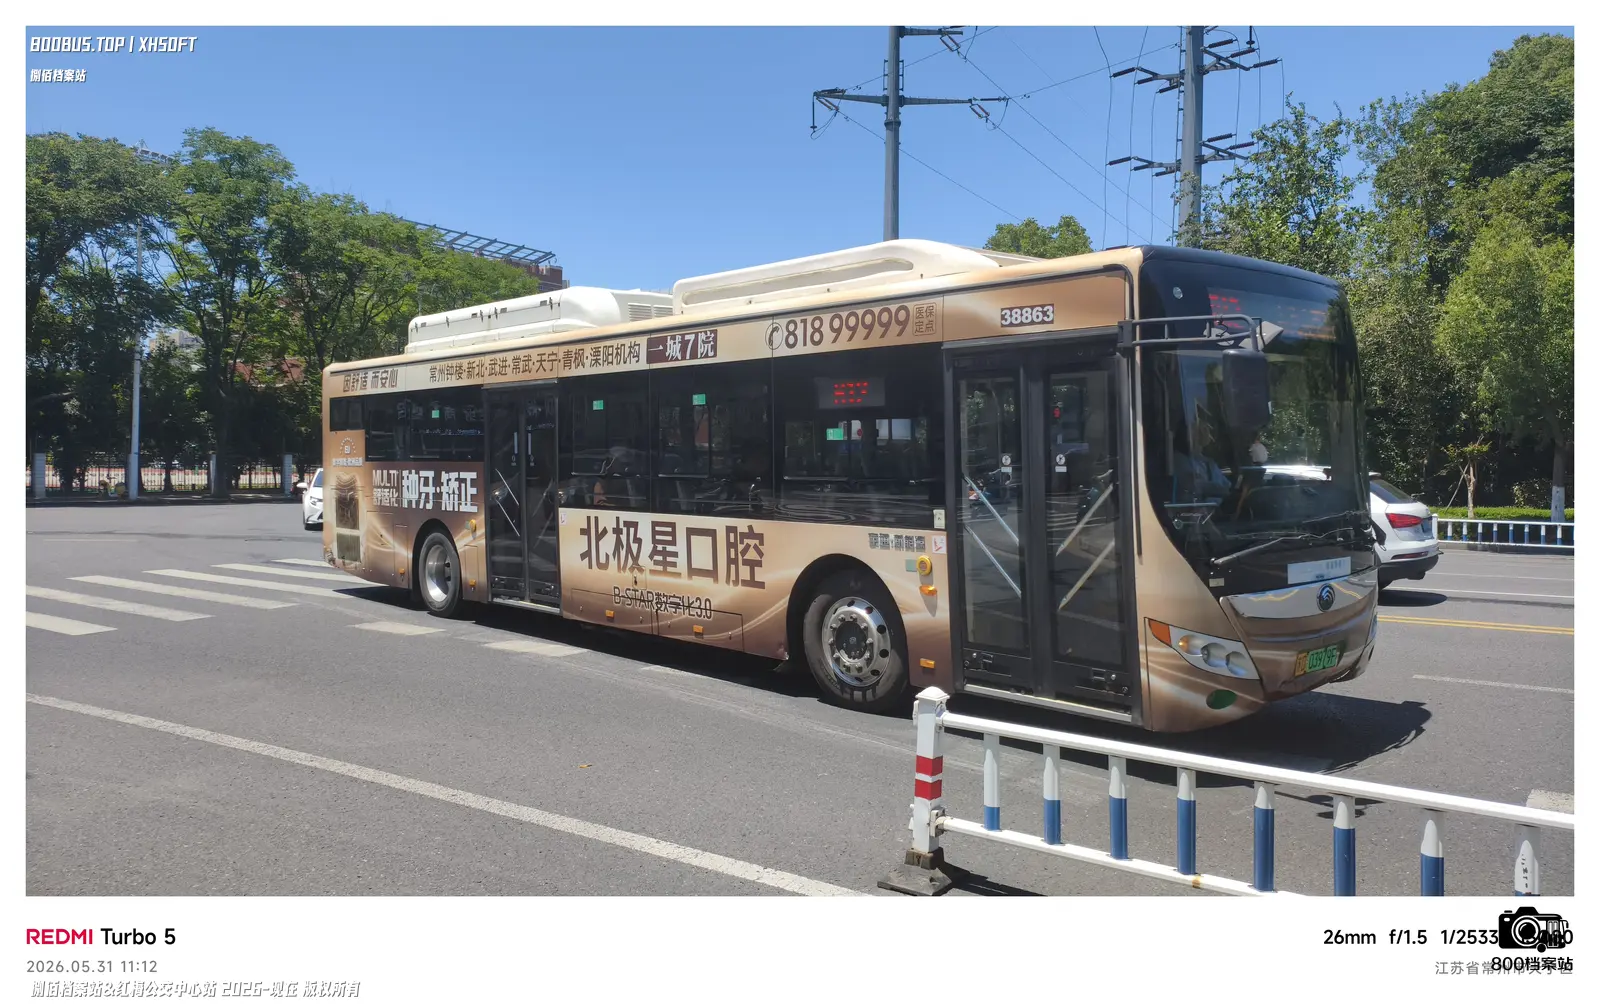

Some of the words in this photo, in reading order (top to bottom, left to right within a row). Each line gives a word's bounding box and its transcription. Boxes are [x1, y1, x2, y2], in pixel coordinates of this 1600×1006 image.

[784, 315, 824, 349] 818
[829, 304, 911, 344] 99999
[914, 320, 935, 334] 定点
[915, 305, 935, 319] 医保
[1001, 305, 1054, 325] 38863
[647, 330, 715, 361] 一城7院
[402, 469, 478, 513] 种牙·矫正
[579, 515, 766, 590] 北极星口腔
